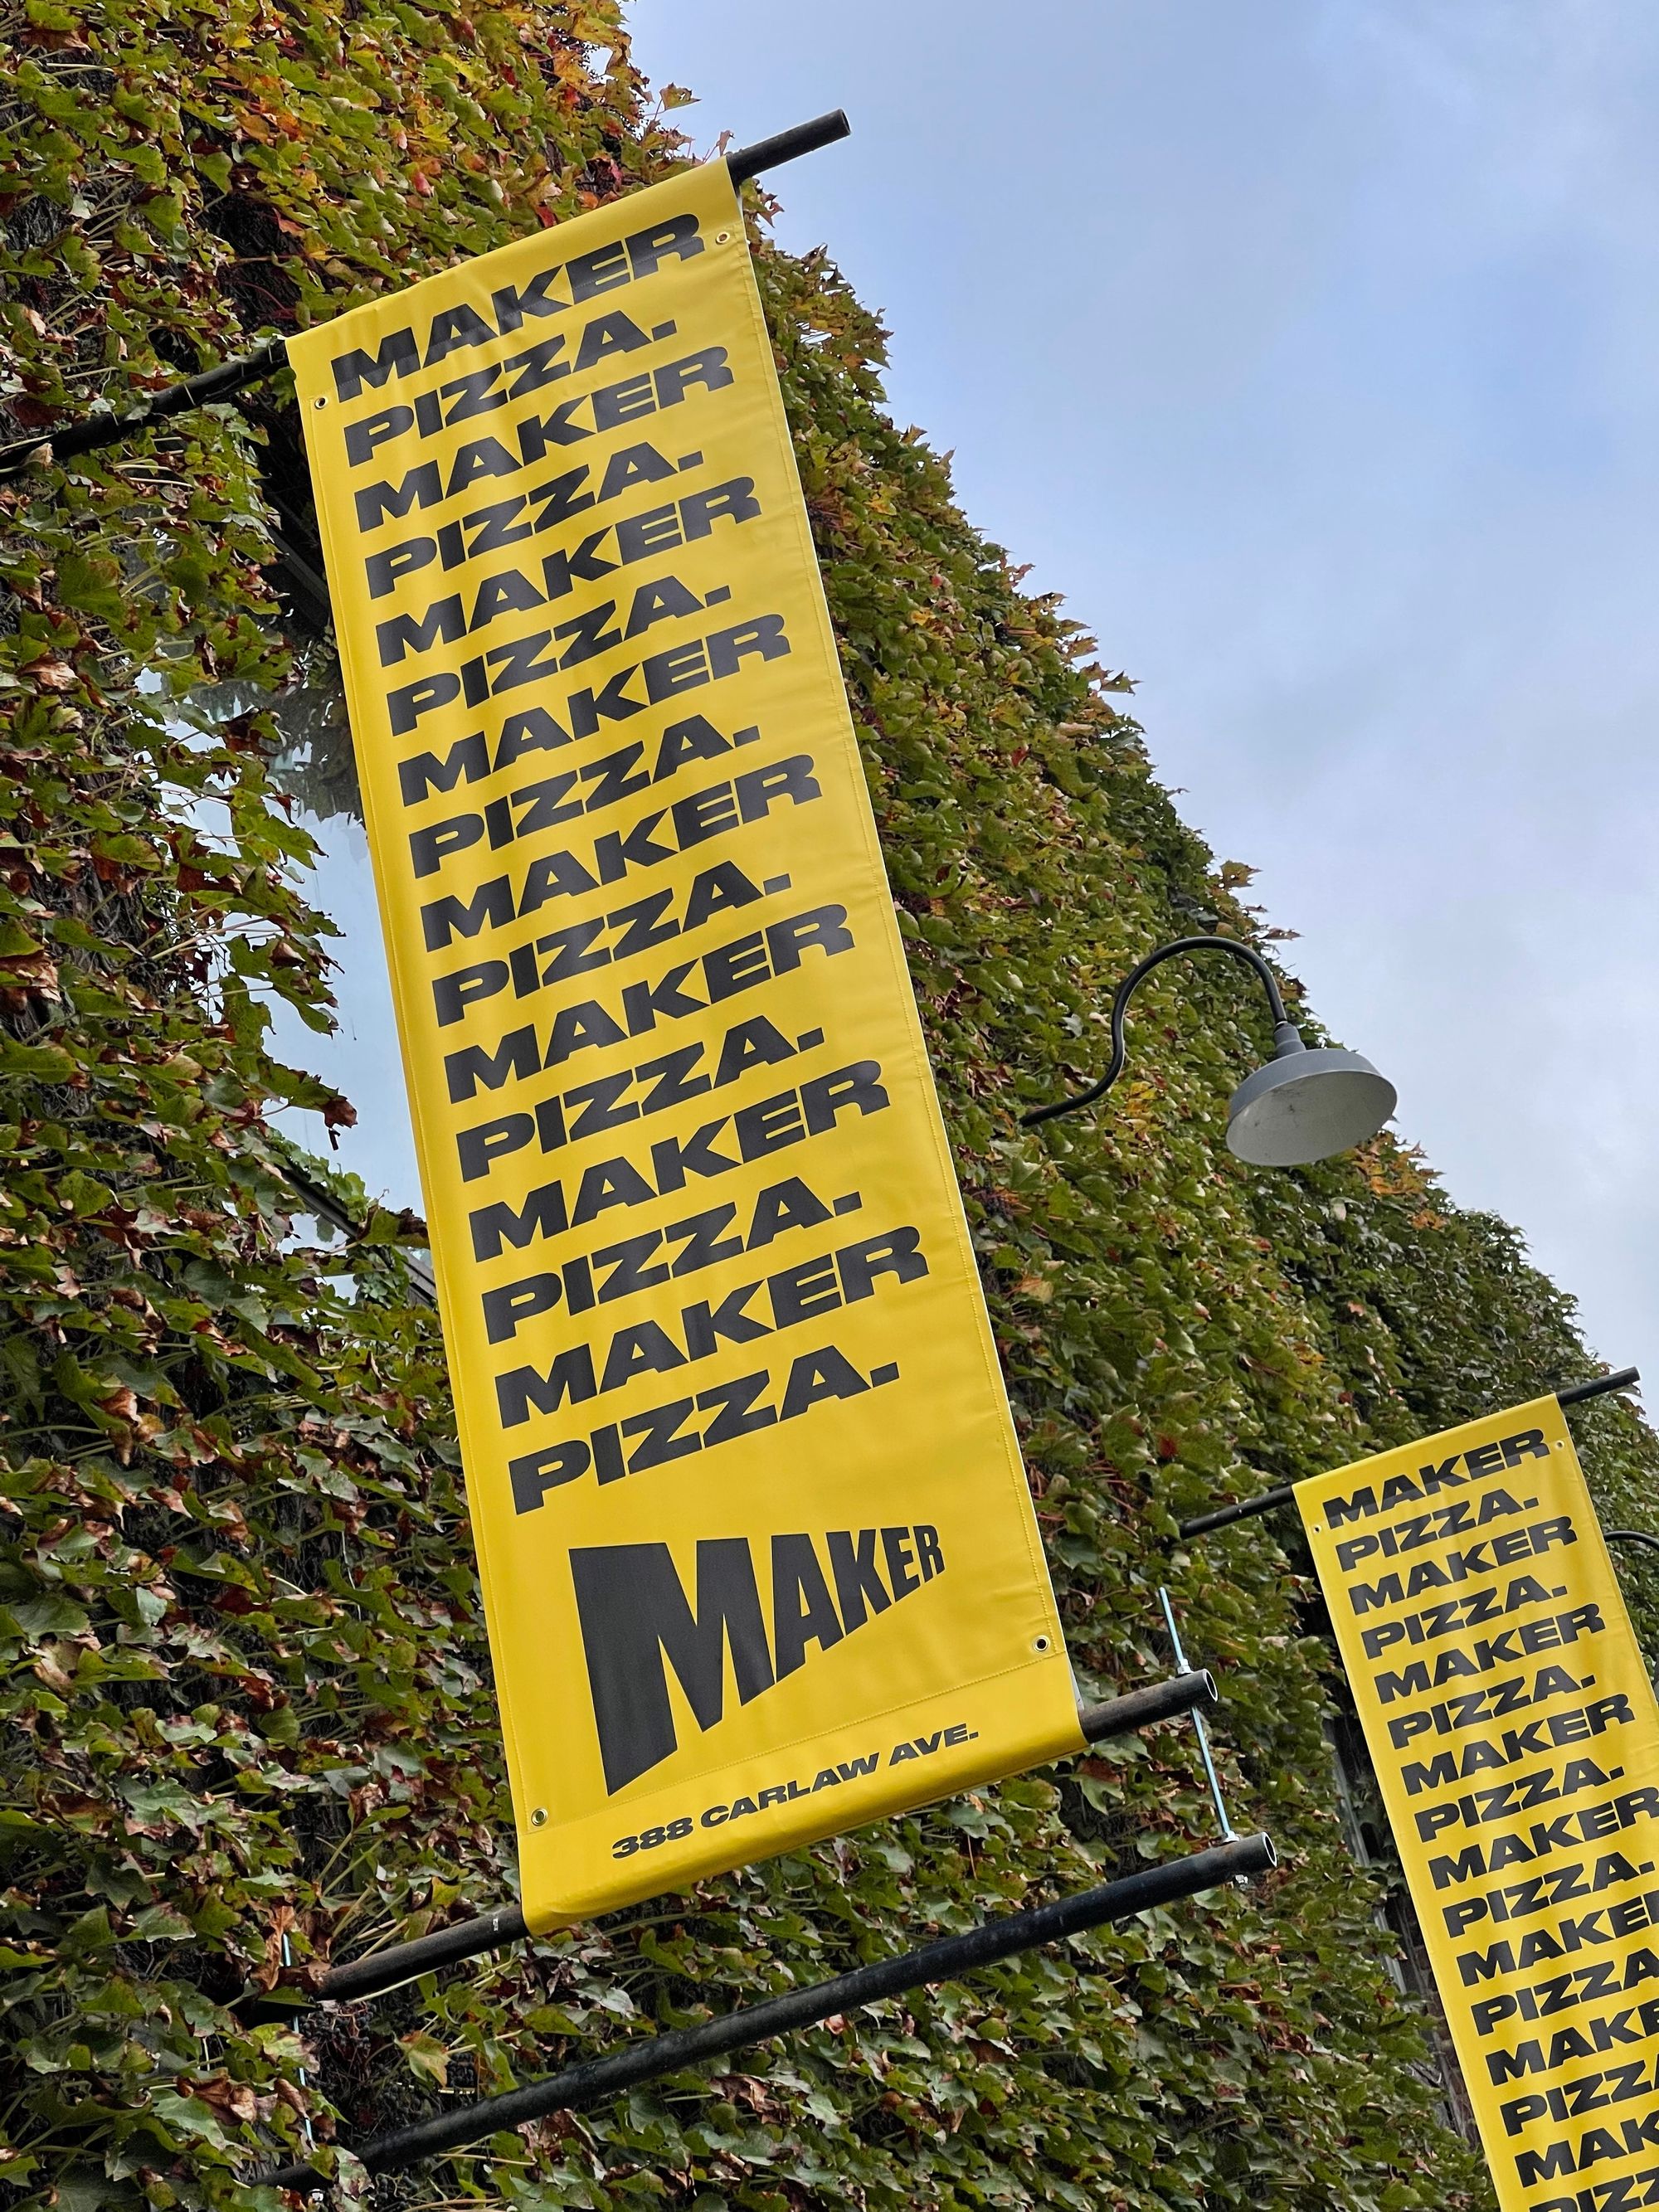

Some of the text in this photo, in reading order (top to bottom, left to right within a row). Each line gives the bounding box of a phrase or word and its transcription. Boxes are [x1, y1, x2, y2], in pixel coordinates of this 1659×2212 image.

[330, 213, 705, 403] MAKER
[343, 309, 678, 468] PIZZA.
[353, 346, 734, 533] MAKER
[364, 441, 704, 600] PIZZA.
[375, 476, 762, 668] MAKER
[386, 575, 732, 737] PIZZA.
[397, 614, 791, 808] MAKER
[408, 714, 761, 879] PIZZA.
[420, 754, 823, 953] MAKER
[431, 860, 792, 1028] PIZZA.
[443, 904, 855, 1105] MAKER
[455, 1014, 825, 1183] PIZZA.
[468, 1060, 891, 1263] MAKER
[481, 1176, 863, 1345] PIZZA.
[494, 1226, 930, 1429] MAKER
[508, 1344, 900, 1515] PIZZA.
[1322, 1428, 1550, 1529] MAKER
[1335, 1488, 1540, 1573] PIZZA.
[1348, 1515, 1578, 1616] MAKER
[567, 1524, 946, 1797] MAKER
[1360, 1575, 1568, 1660] PIZZA.
[1374, 1603, 1606, 1704] MAKER
[1387, 1665, 1596, 1750] PIZZA.
[1400, 1694, 1636, 1796] MAKER
[612, 1723, 980, 1859] 388 CARLAW AVE.
[1413, 1757, 1625, 1843] PIZZA.
[1428, 1787, 1659, 1890] MAKER
[1442, 1851, 1656, 1938] PIZZA.
[1499, 2053, 1659, 2137] PIZZ
